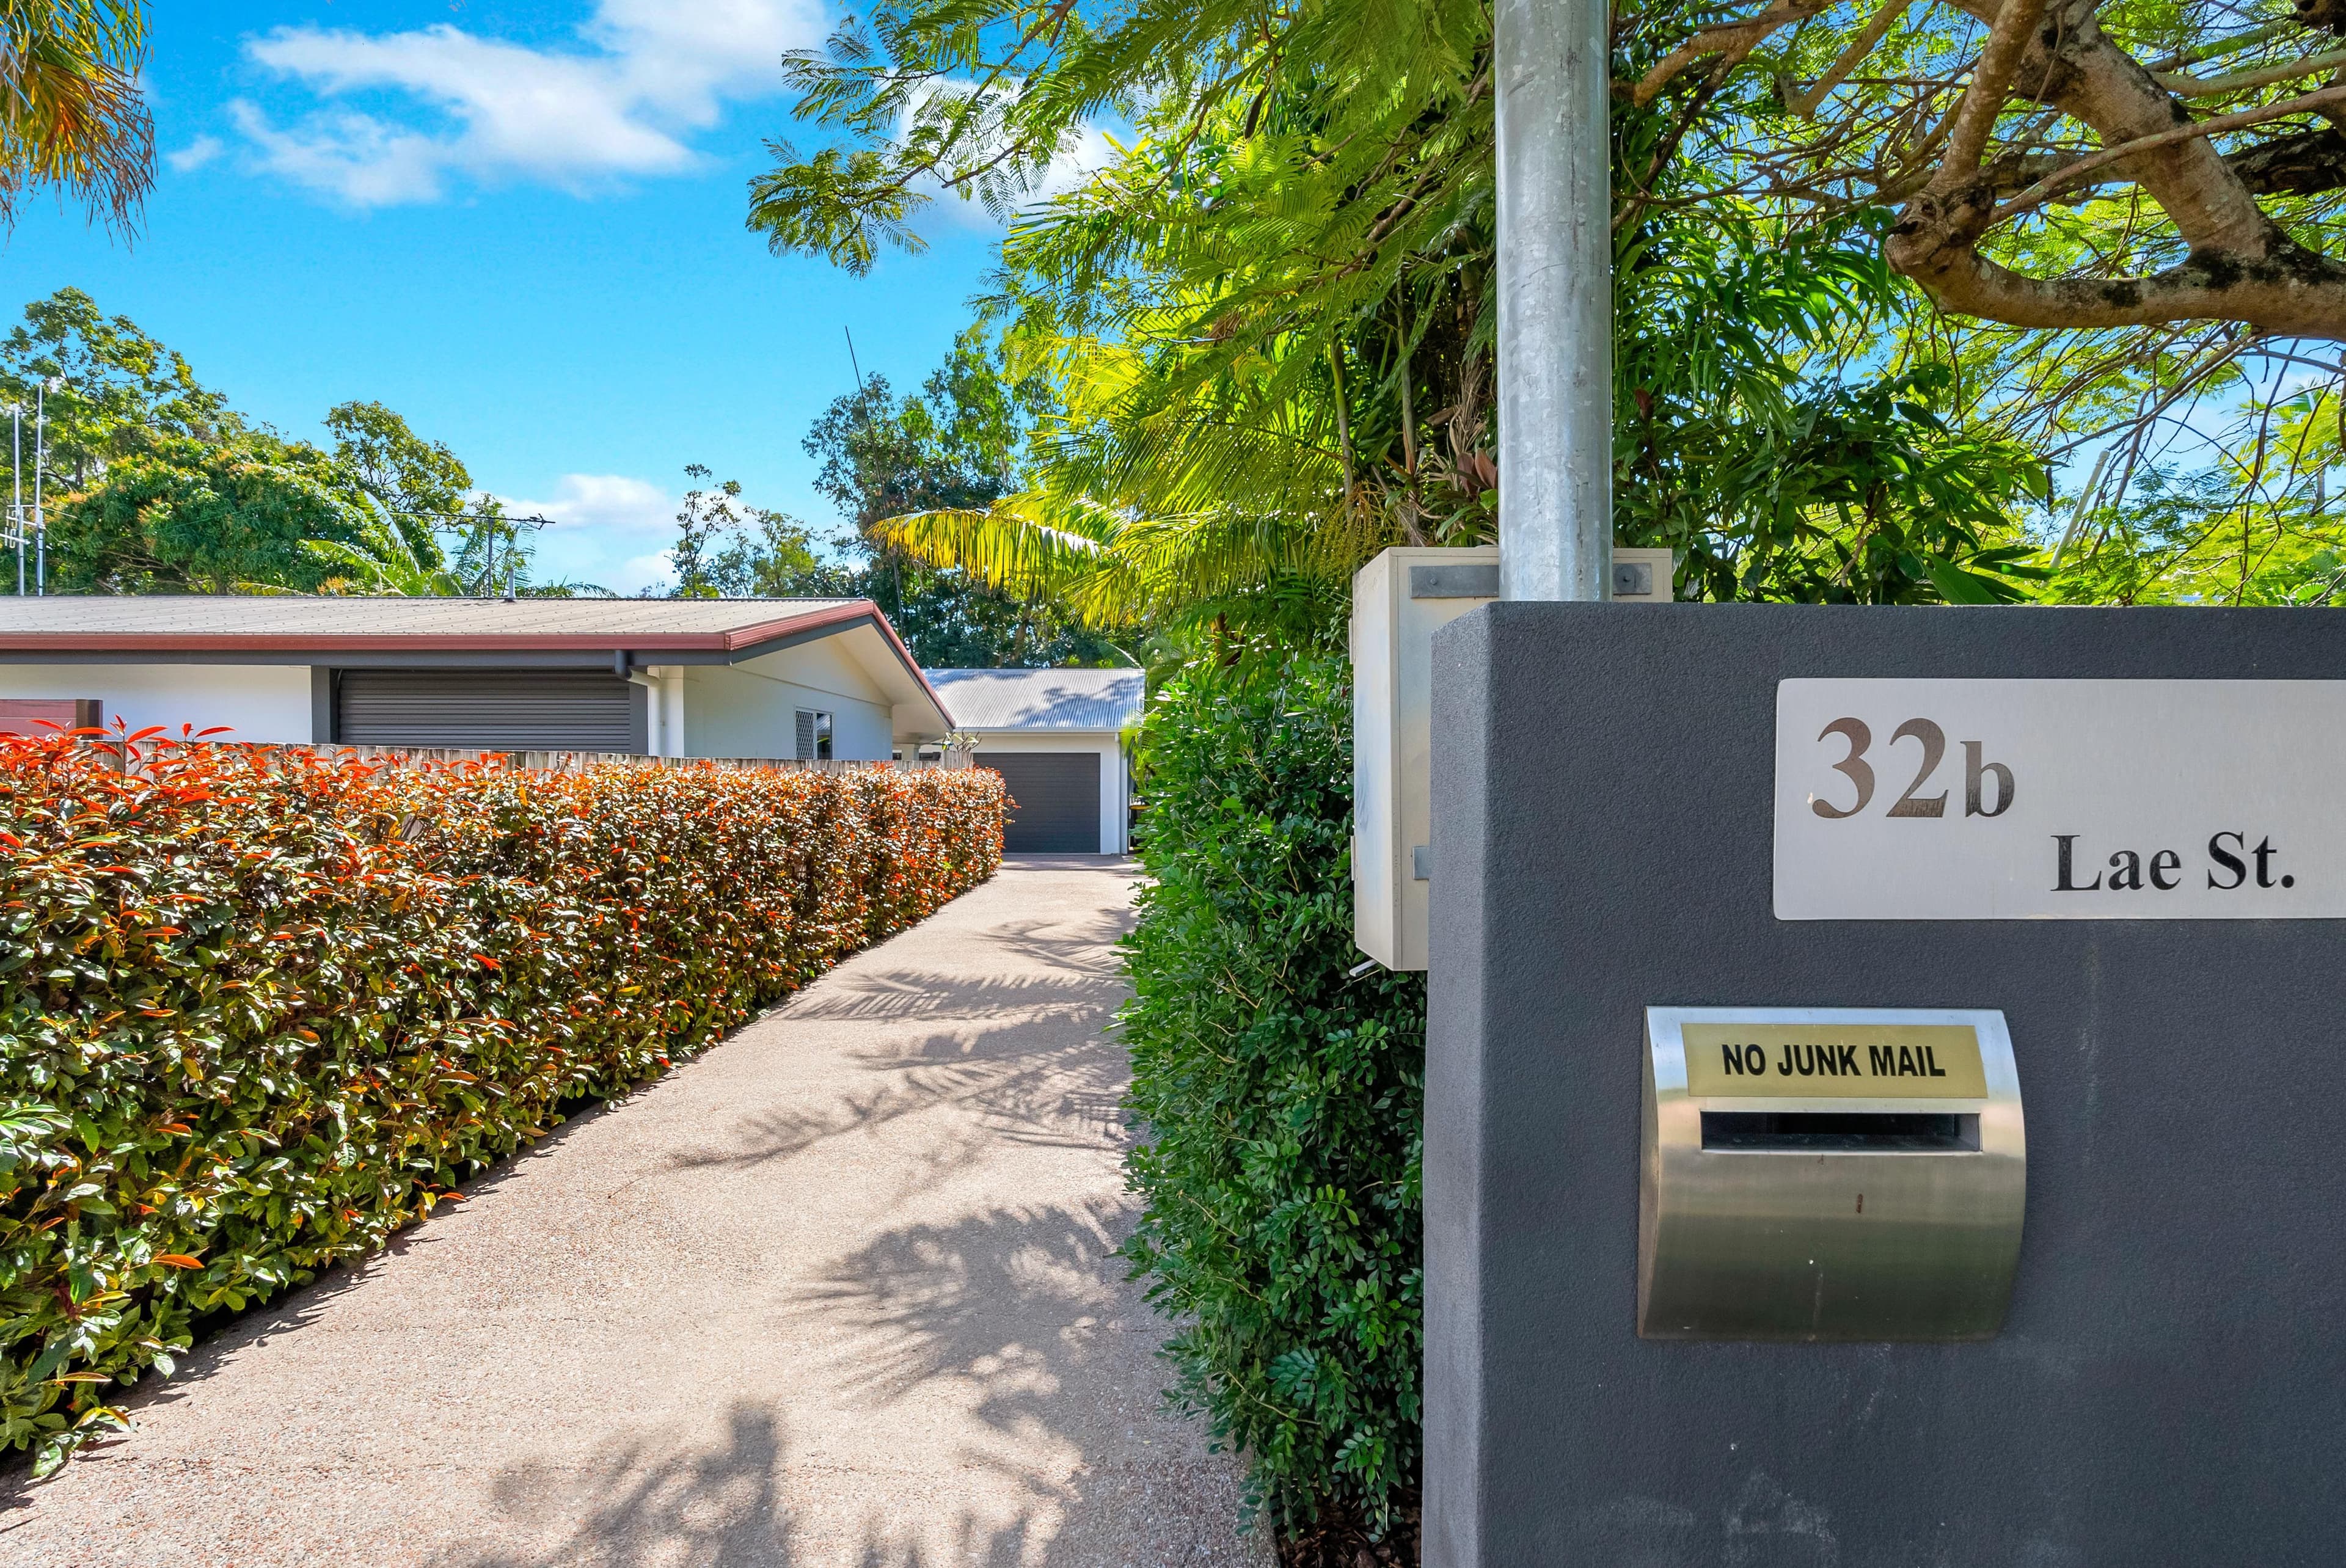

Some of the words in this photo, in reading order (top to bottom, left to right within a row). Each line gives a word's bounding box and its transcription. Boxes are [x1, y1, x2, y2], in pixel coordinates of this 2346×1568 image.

[1811, 717, 2015, 819] 32b
[2050, 834, 2182, 892] Lae
[2207, 831, 2295, 891] St.
[1721, 1043, 1766, 1075] NO
[1777, 1045, 1862, 1076] JUNK
[1869, 1045, 1946, 1077] MAIL
